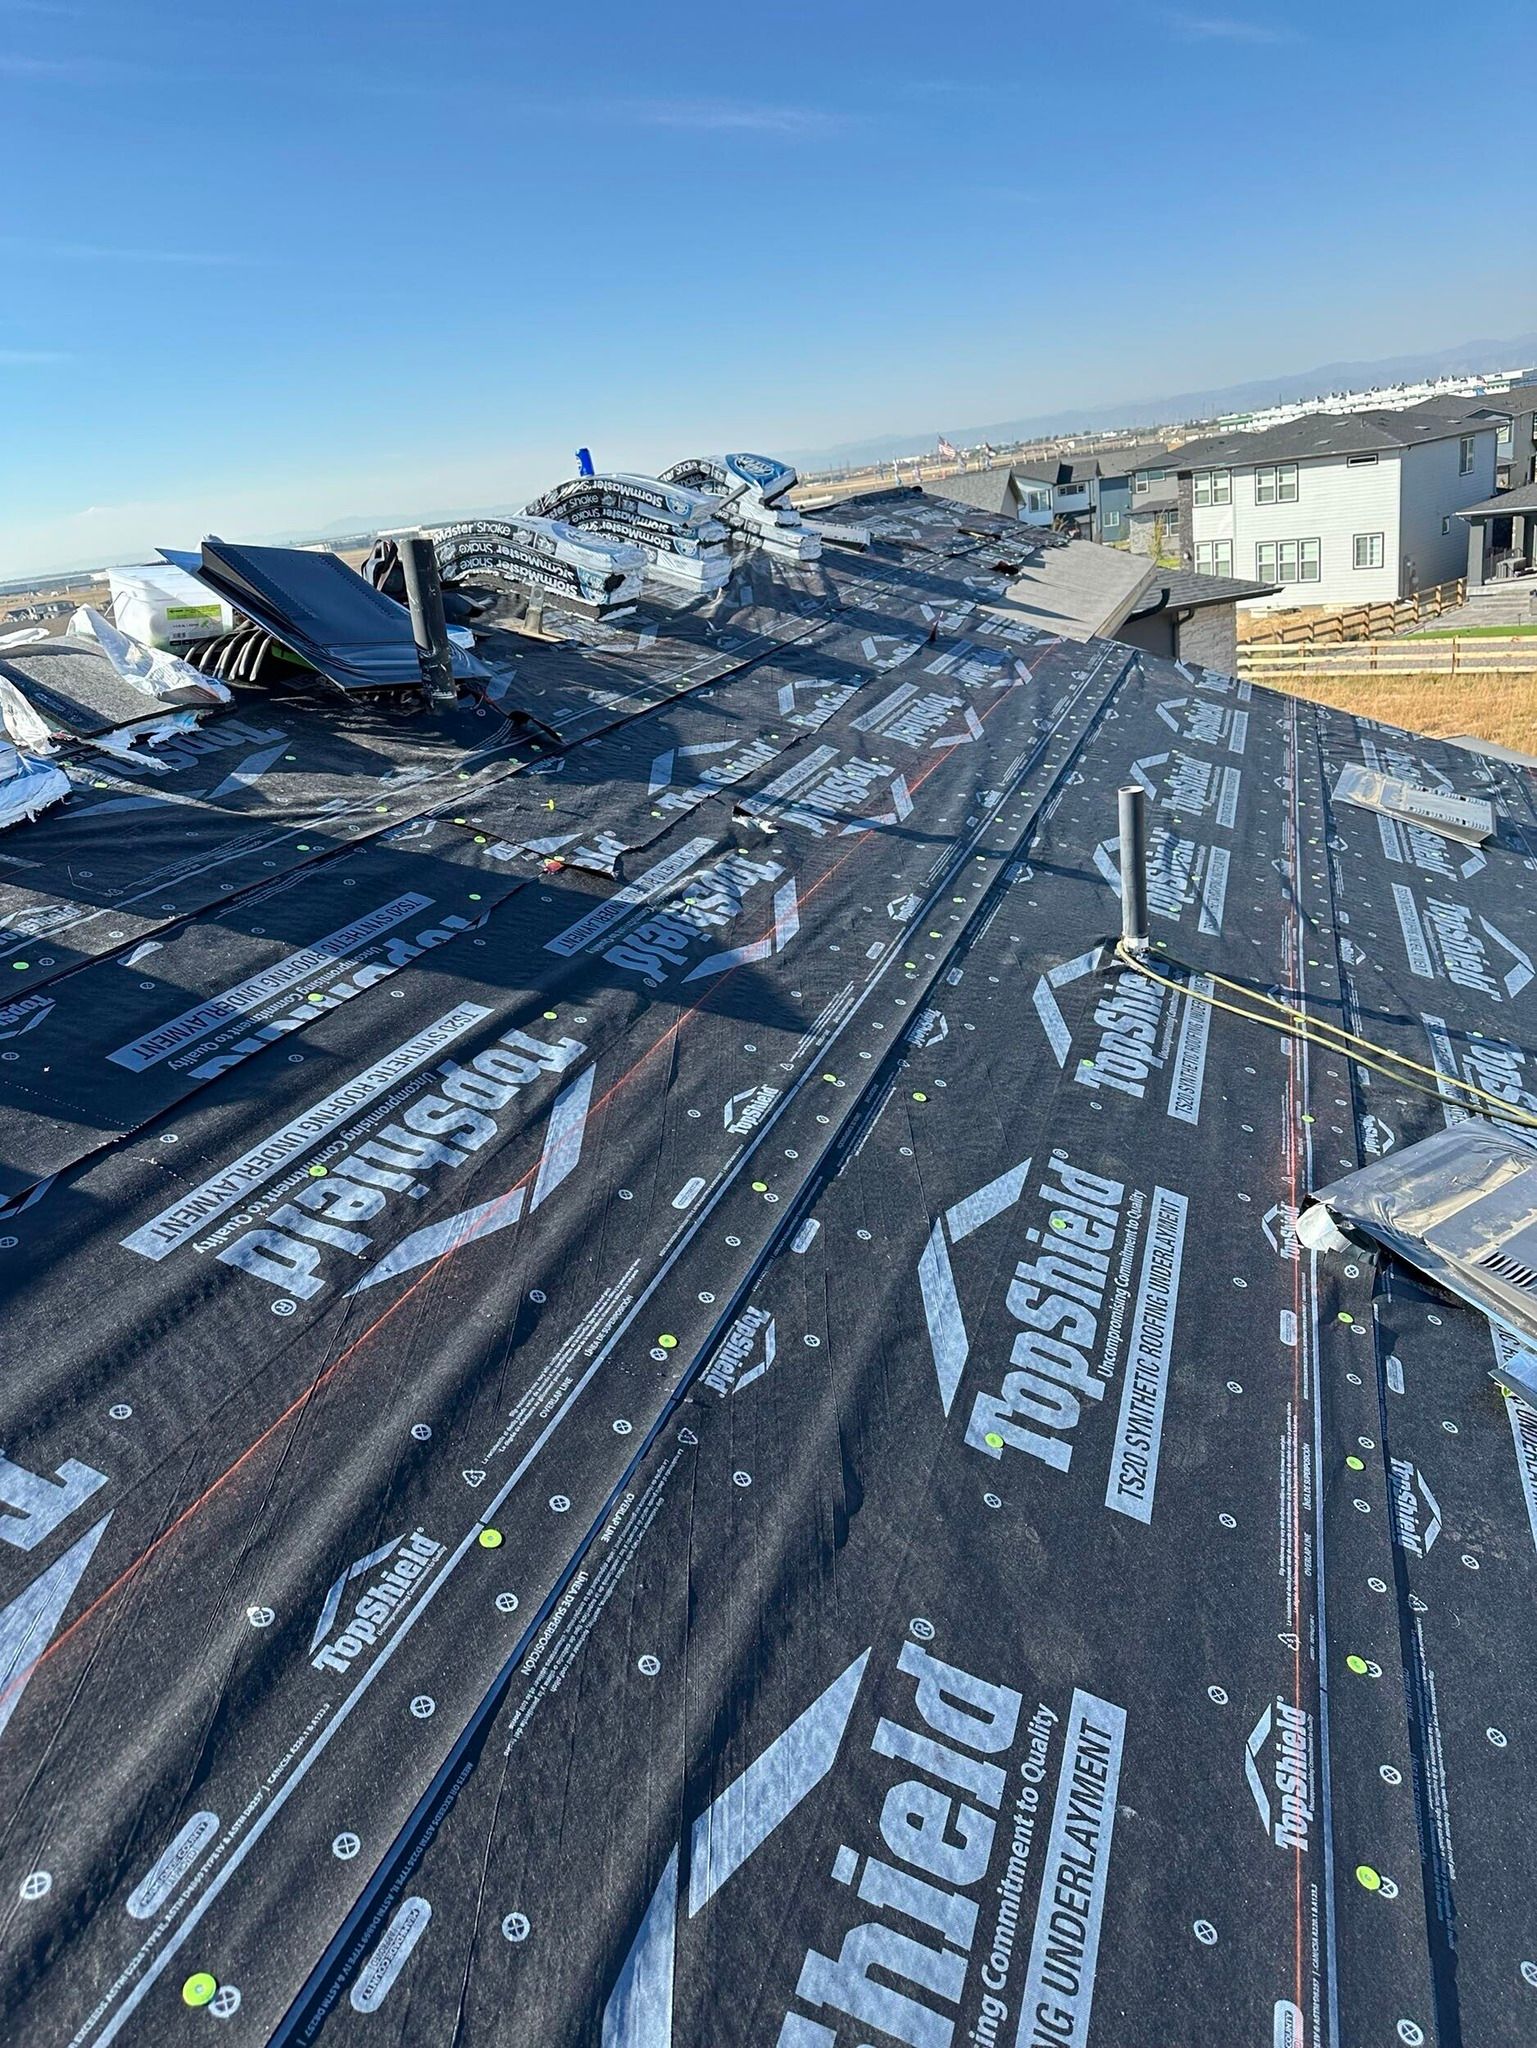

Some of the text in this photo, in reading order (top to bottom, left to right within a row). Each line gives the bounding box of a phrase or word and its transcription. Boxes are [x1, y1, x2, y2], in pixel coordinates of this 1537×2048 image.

[569, 493, 599, 506] Shake
[571, 508, 600, 523] Shake
[592, 479, 663, 508] StormMaster
[433, 522, 474, 546] Master
[476, 521, 511, 536] Shake
[599, 522, 671, 550] StormMaster
[602, 508, 669, 533] StormMaster
[458, 542, 575, 581] StormMaster Shake
[460, 557, 578, 596] StormMaster Shake
[131, 898, 419, 1065] TS20 SYNTHETIC ROOFING UNDERLAYMENT
[167, 946, 381, 1070] Uncompromising Commitment to Quality
[1184, 1021, 1203, 1052] ROOFING
[1177, 1051, 1199, 1094] SYNTHETIC
[339, 1072, 436, 1144] Uncompromising
[727, 1084, 779, 1135] TopShield
[1174, 1092, 1194, 1114] TS20
[150, 1010, 479, 1243] TS20 SYNTHETIC ROOFING UNDERLAYMENT
[216, 1029, 588, 1300] TopShield
[247, 1201, 265, 1213] to
[192, 1206, 252, 1253] Quality
[1280, 1202, 1300, 1260] TopShield
[1096, 1188, 1147, 1377] Uncompromising Commitment to Quality
[583, 1340, 600, 1356] LÍNEA
[601, 1294, 633, 1333] SUPERPOSICIÓN
[964, 1157, 1125, 1473] TopShield
[703, 1305, 771, 1395] TopShield
[1117, 1197, 1180, 1500] TS20 SYNTHETIC ROOFING UNDERLAYMENT
[540, 1376, 573, 1418] OVERLAP LINE
[1301, 1442, 1310, 1485] SUPERPOSICIÓN
[600, 1492, 634, 1542] OVERLAP LINE
[1390, 1458, 1423, 1556] TopShield
[1303, 1532, 1311, 1576] OVERLAP LINE
[310, 1532, 442, 1674] TopShield
[520, 1570, 588, 1675] LÍNEA DE SUPERPOSICIÓN
[456, 1761, 473, 1785] MEETS
[1274, 1704, 1312, 1852] TopShield
[431, 1794, 453, 1825] EXCEEDS
[418, 1824, 435, 1846] ASTM
[775, 1638, 1023, 2048] hield
[981, 1702, 1058, 1990] Commitment to Quality
[1041, 1717, 1113, 1996] UNDERLAYMENT
[395, 1866, 411, 1885] TYPE
[73, 2000, 108, 2043] EXCEEDS
[105, 1974, 127, 2002] ASTM
[140, 1929, 161, 1951] TYPE
[164, 1896, 185, 1922] ASTM
[200, 1852, 219, 1872] TYPE
[214, 1842, 224, 1855] IV
[227, 1814, 246, 1837] ASTM
[242, 1790, 263, 1816] D8257
[266, 1753, 293, 1784] CAN/CSA
[376, 1893, 394, 1916] ASTM
[347, 1943, 365, 1964] TYPE
[321, 1981, 340, 2007] ASTM
[361, 1957, 391, 2000] COUNTY
